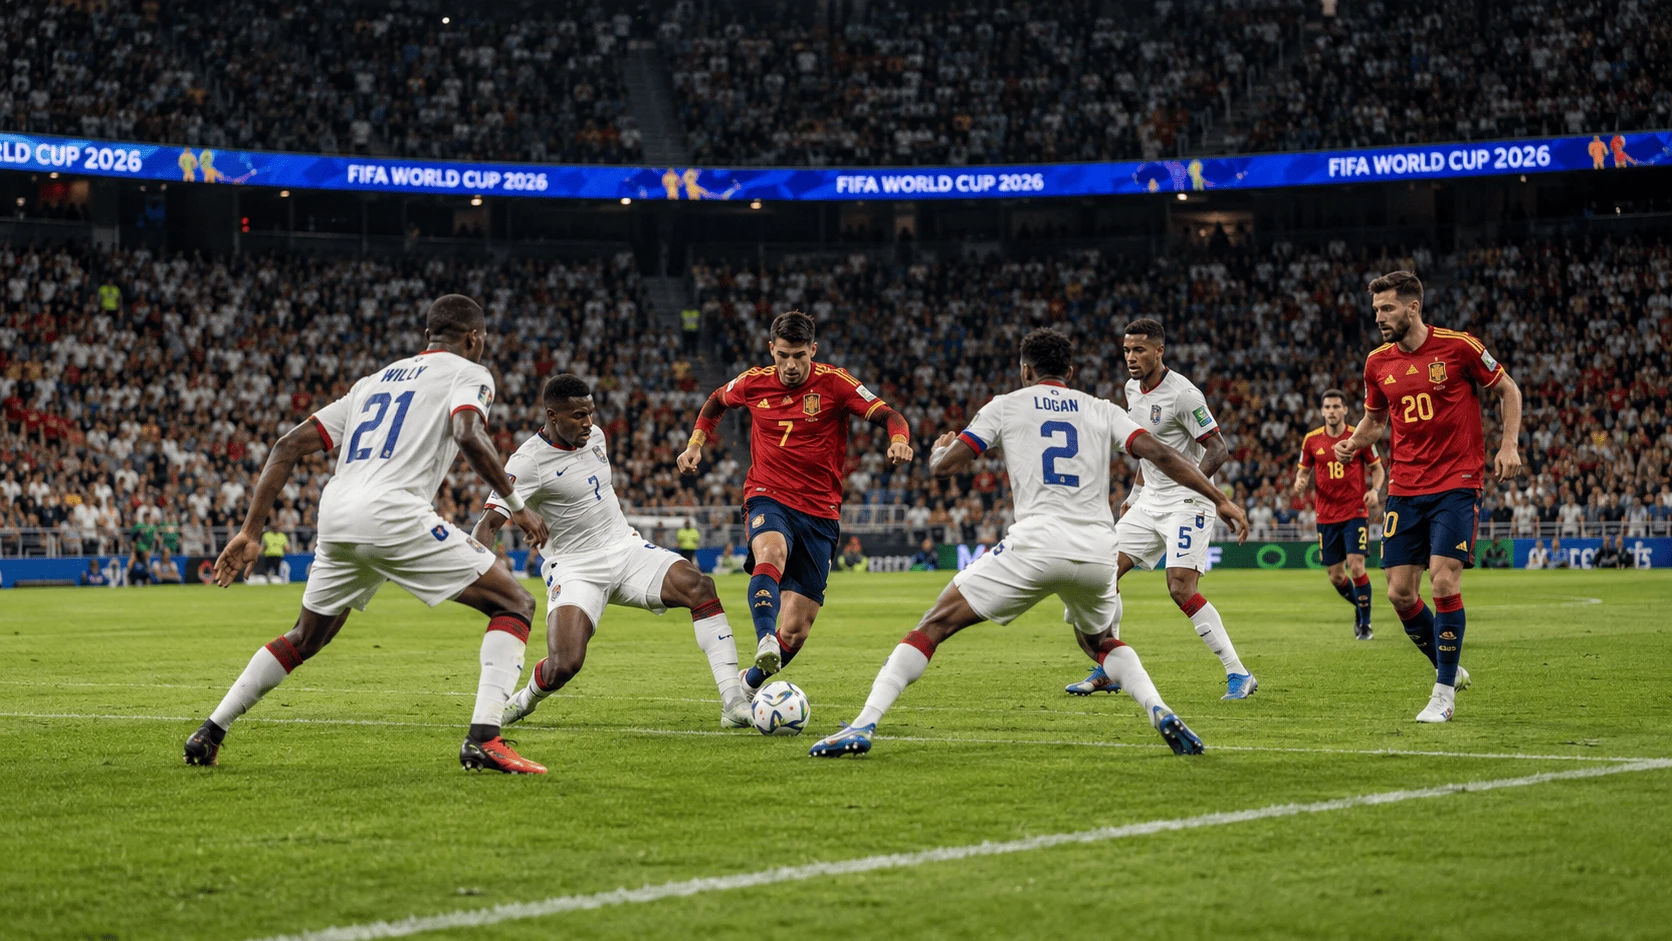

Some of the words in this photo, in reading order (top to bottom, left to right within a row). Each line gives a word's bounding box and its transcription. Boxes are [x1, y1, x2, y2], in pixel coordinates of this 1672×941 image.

[0, 141, 31, 163] LD
[35, 143, 80, 167] CUP
[84, 147, 142, 172] 2026
[1328, 156, 1370, 177] FIFA
[1373, 151, 1445, 174] WORLD
[1448, 149, 1490, 171] CUP
[1494, 145, 1551, 168] 2026
[348, 164, 389, 184] FIFA
[391, 166, 460, 188] WORLD
[462, 170, 501, 189] CUP
[503, 172, 548, 191] 2026
[836, 175, 879, 193] FIFA
[881, 175, 953, 193] WORLD
[955, 174, 996, 192] CUP
[998, 173, 1044, 192] 2026
[380, 365, 428, 382] WILLY
[1034, 396, 1079, 413] LOGAN
[1401, 392, 1435, 424] 20
[345, 390, 416, 464] 21
[778, 420, 794, 447] 7
[1040, 420, 1080, 488] 2
[1327, 461, 1345, 479] 18
[588, 475, 601, 500] 7
[1178, 526, 1192, 549] 5
[1383, 511, 1399, 538] 0
